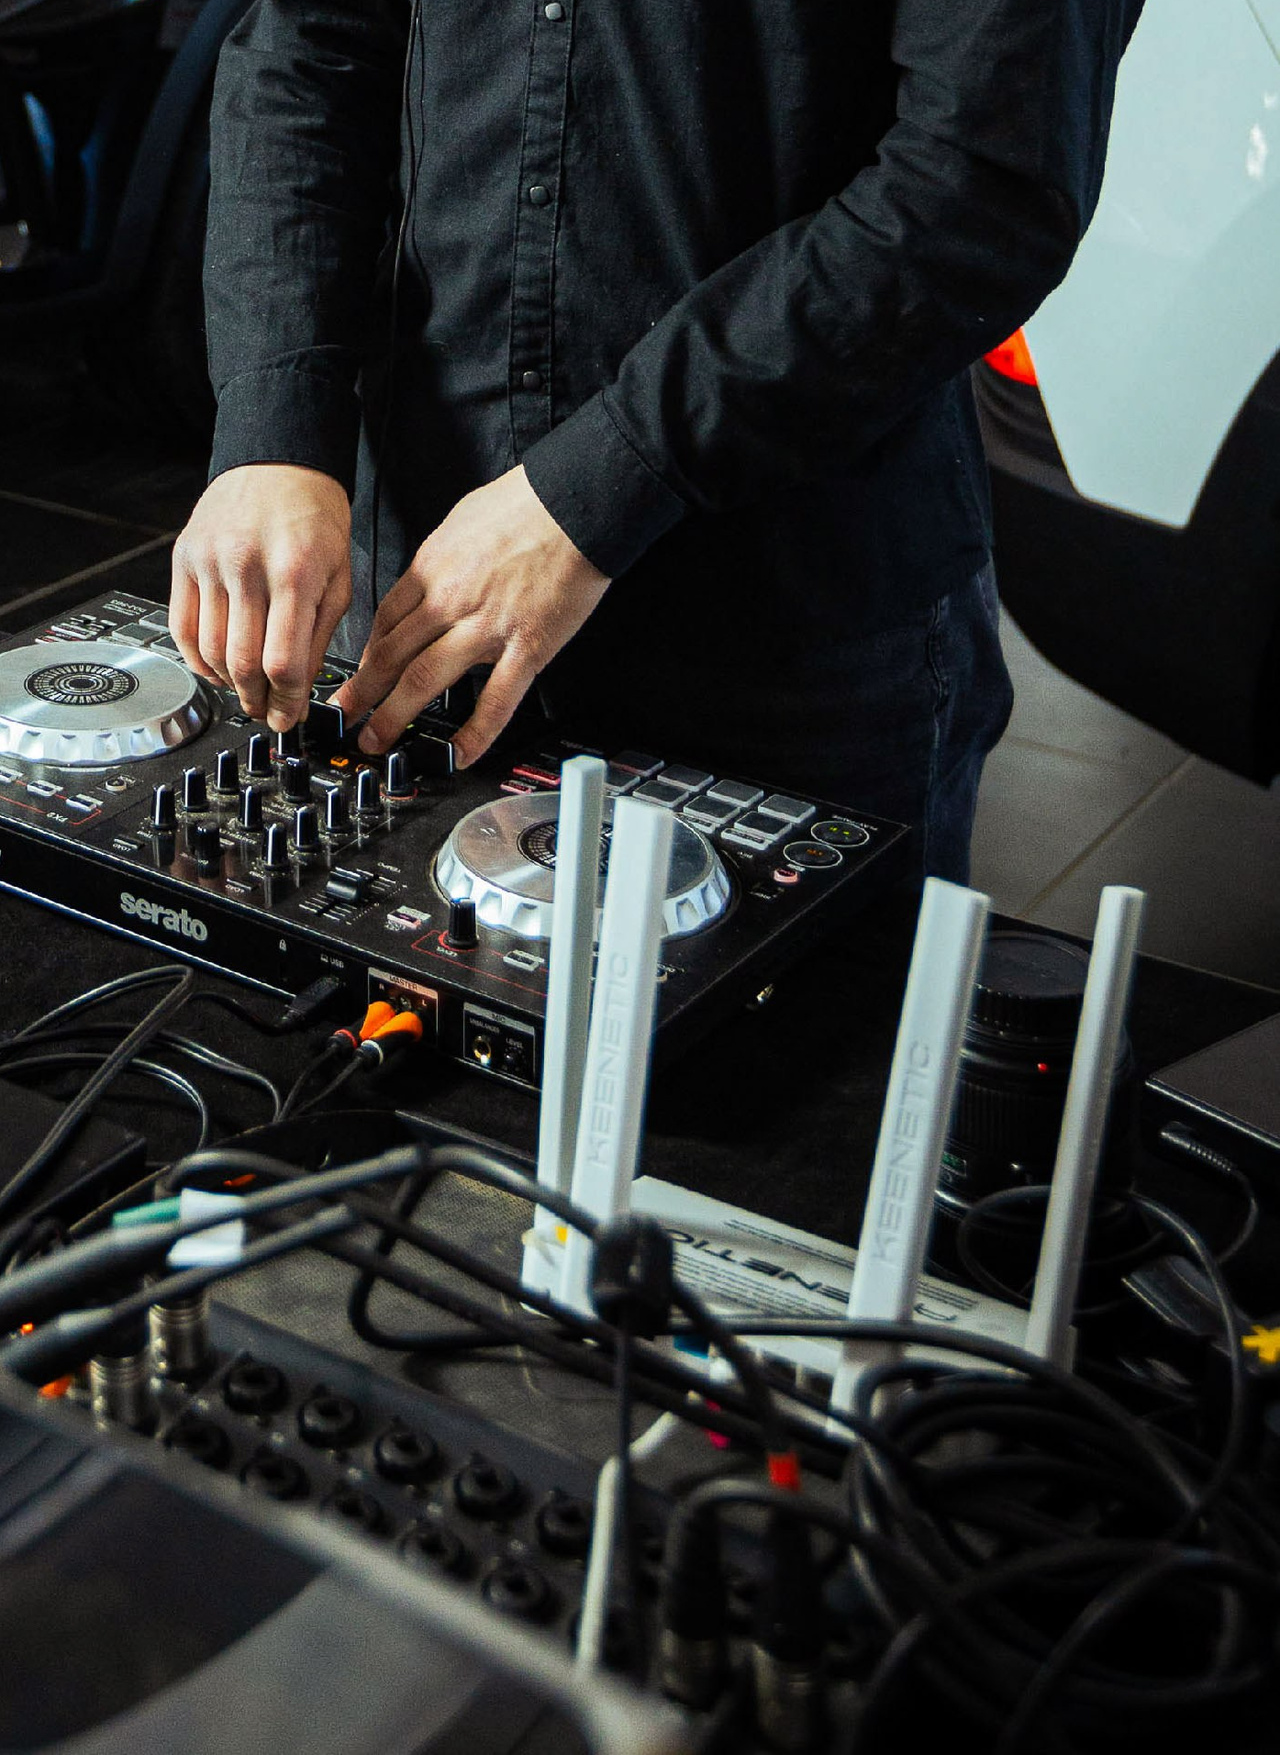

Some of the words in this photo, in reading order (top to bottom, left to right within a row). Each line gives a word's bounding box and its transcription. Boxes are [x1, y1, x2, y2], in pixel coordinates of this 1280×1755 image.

[120, 891, 209, 942] serato
[389, 974, 419, 991] MASTER
[871, 1040, 930, 1261] KEENETIC
